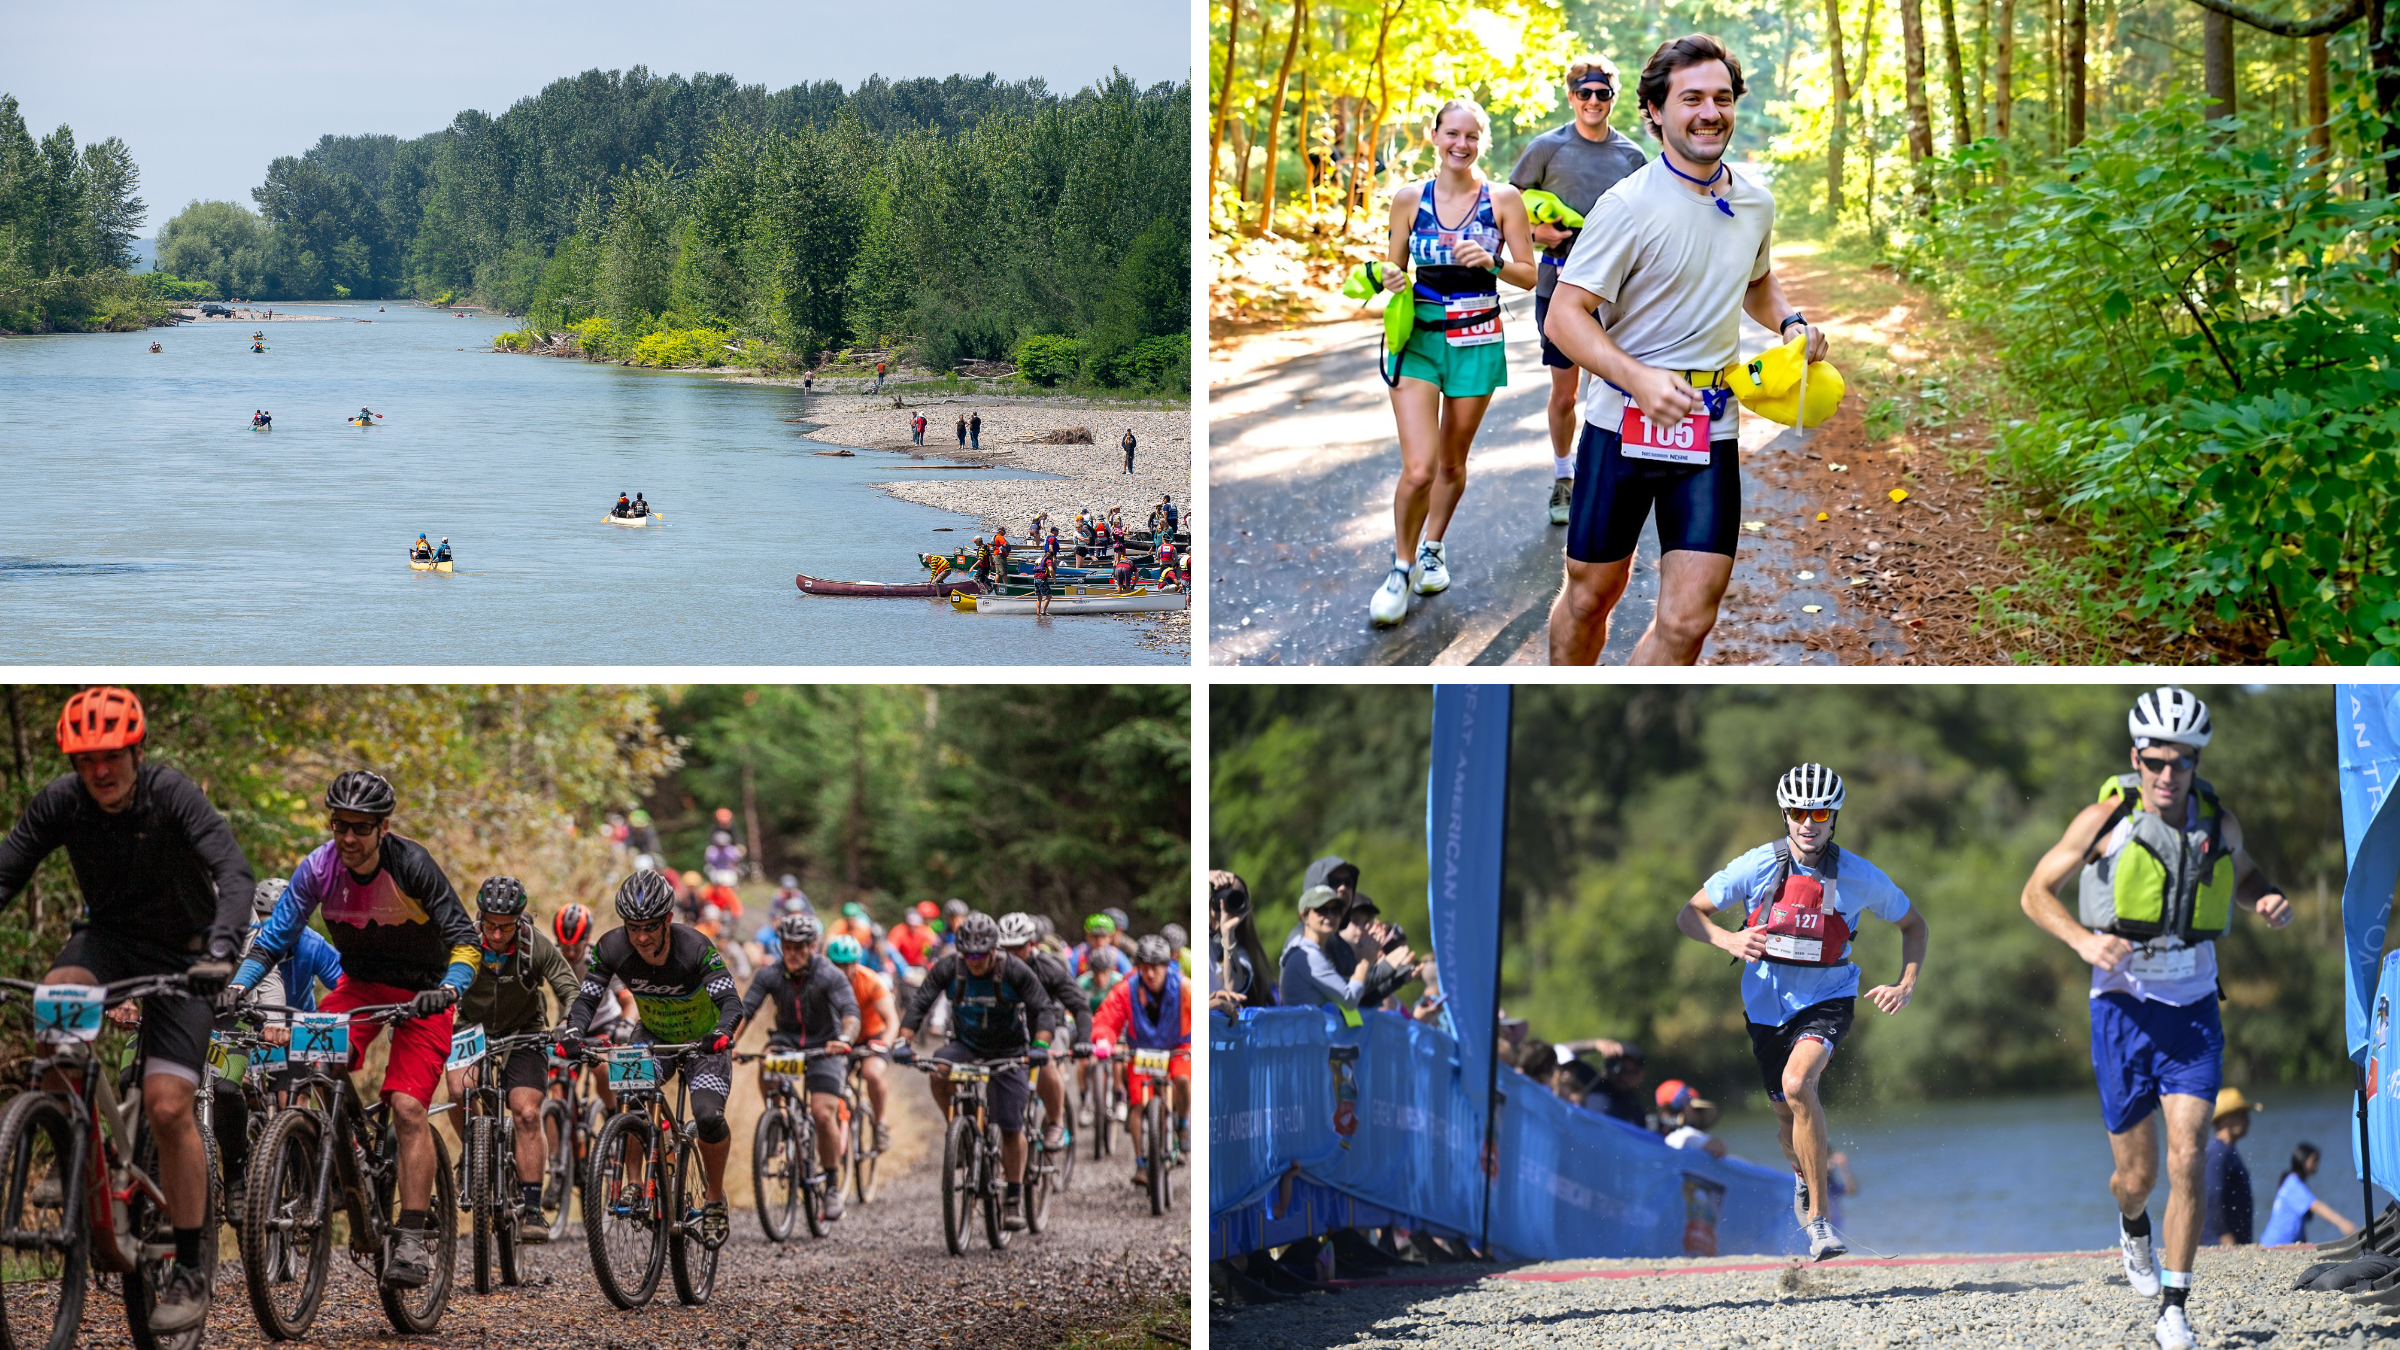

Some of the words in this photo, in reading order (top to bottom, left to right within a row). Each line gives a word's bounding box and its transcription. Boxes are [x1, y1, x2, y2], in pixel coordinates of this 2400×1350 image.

[1640, 415, 1694, 449] 105
[1802, 799, 1815, 807] 127
[1443, 750, 1468, 899] AMERICAN
[1794, 913, 1818, 929] 127
[53, 1001, 83, 1029] 12
[652, 1005, 698, 1017] ENDURANCE
[306, 1028, 333, 1051] 25
[455, 1039, 477, 1060] 20
[621, 1061, 643, 1081] 22
